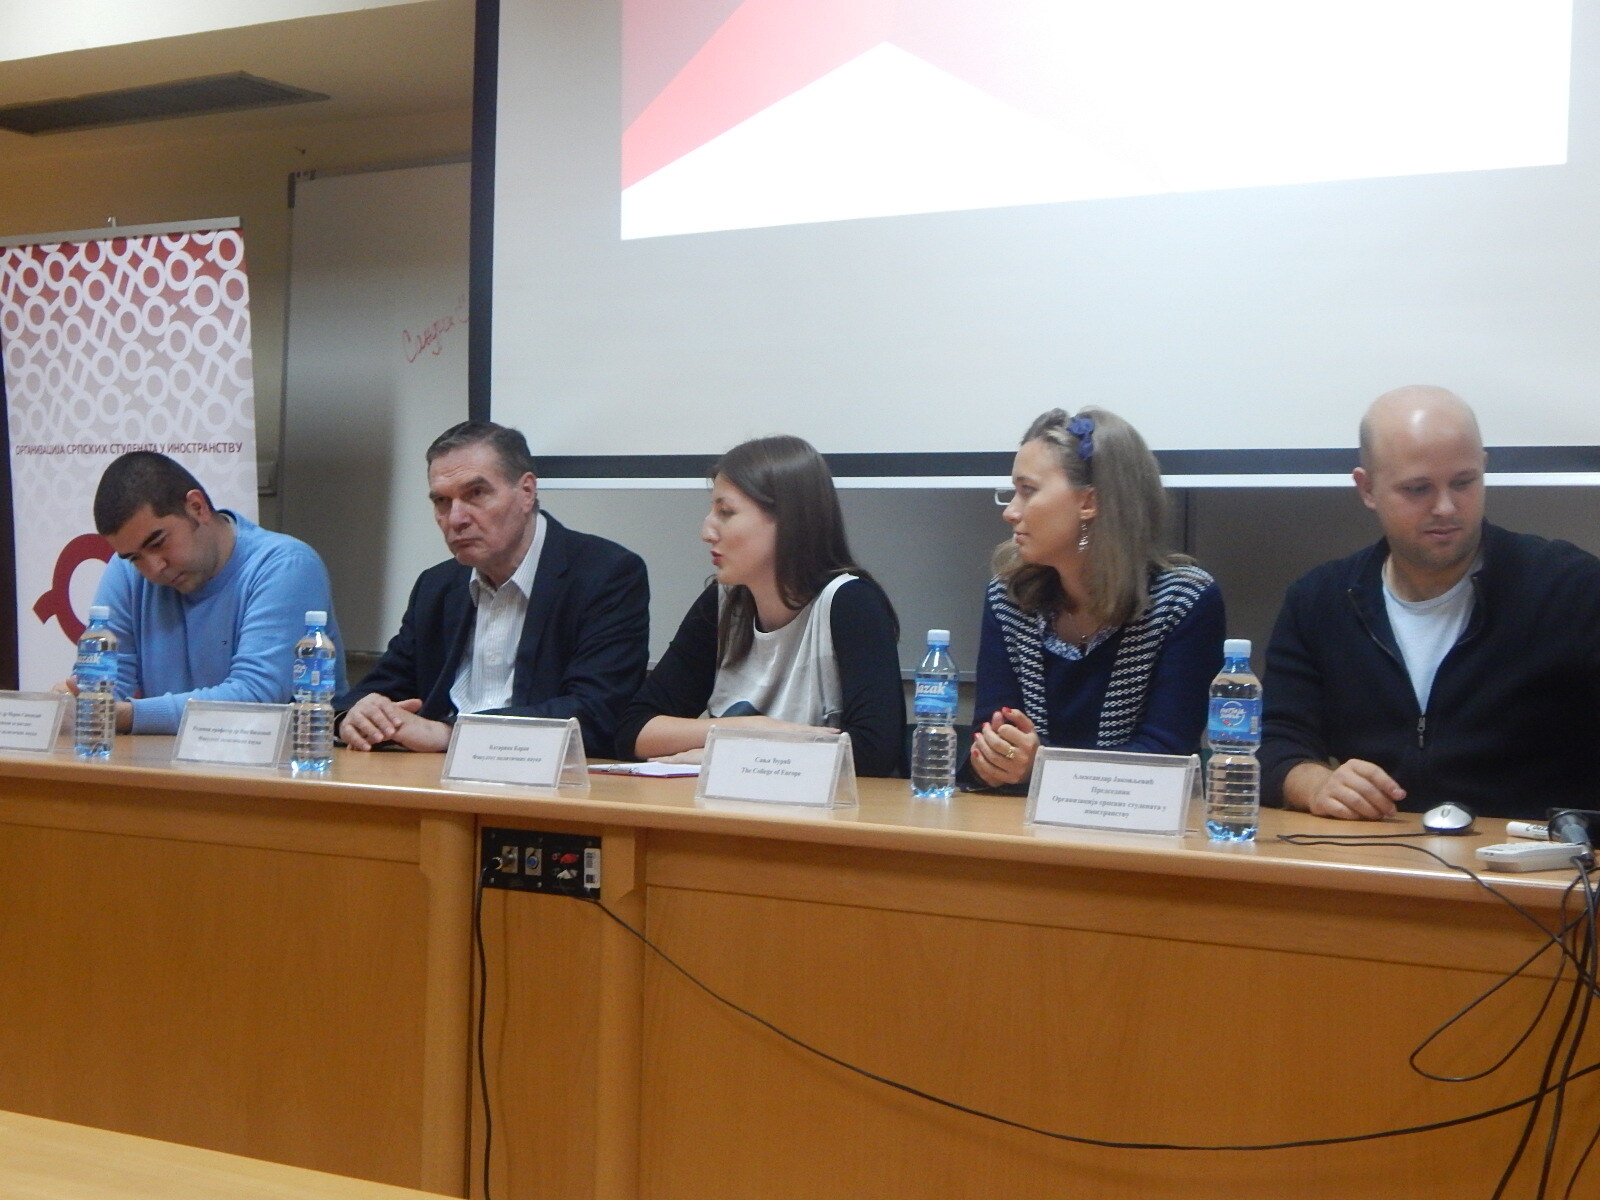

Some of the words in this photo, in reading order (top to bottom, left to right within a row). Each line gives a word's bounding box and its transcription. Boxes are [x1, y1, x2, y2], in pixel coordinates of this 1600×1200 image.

[66, 444, 107, 455] СРПСКИХ
[167, 442, 242, 453] ИНОСТРАНСТВУ
[780, 770, 802, 778] Europe
